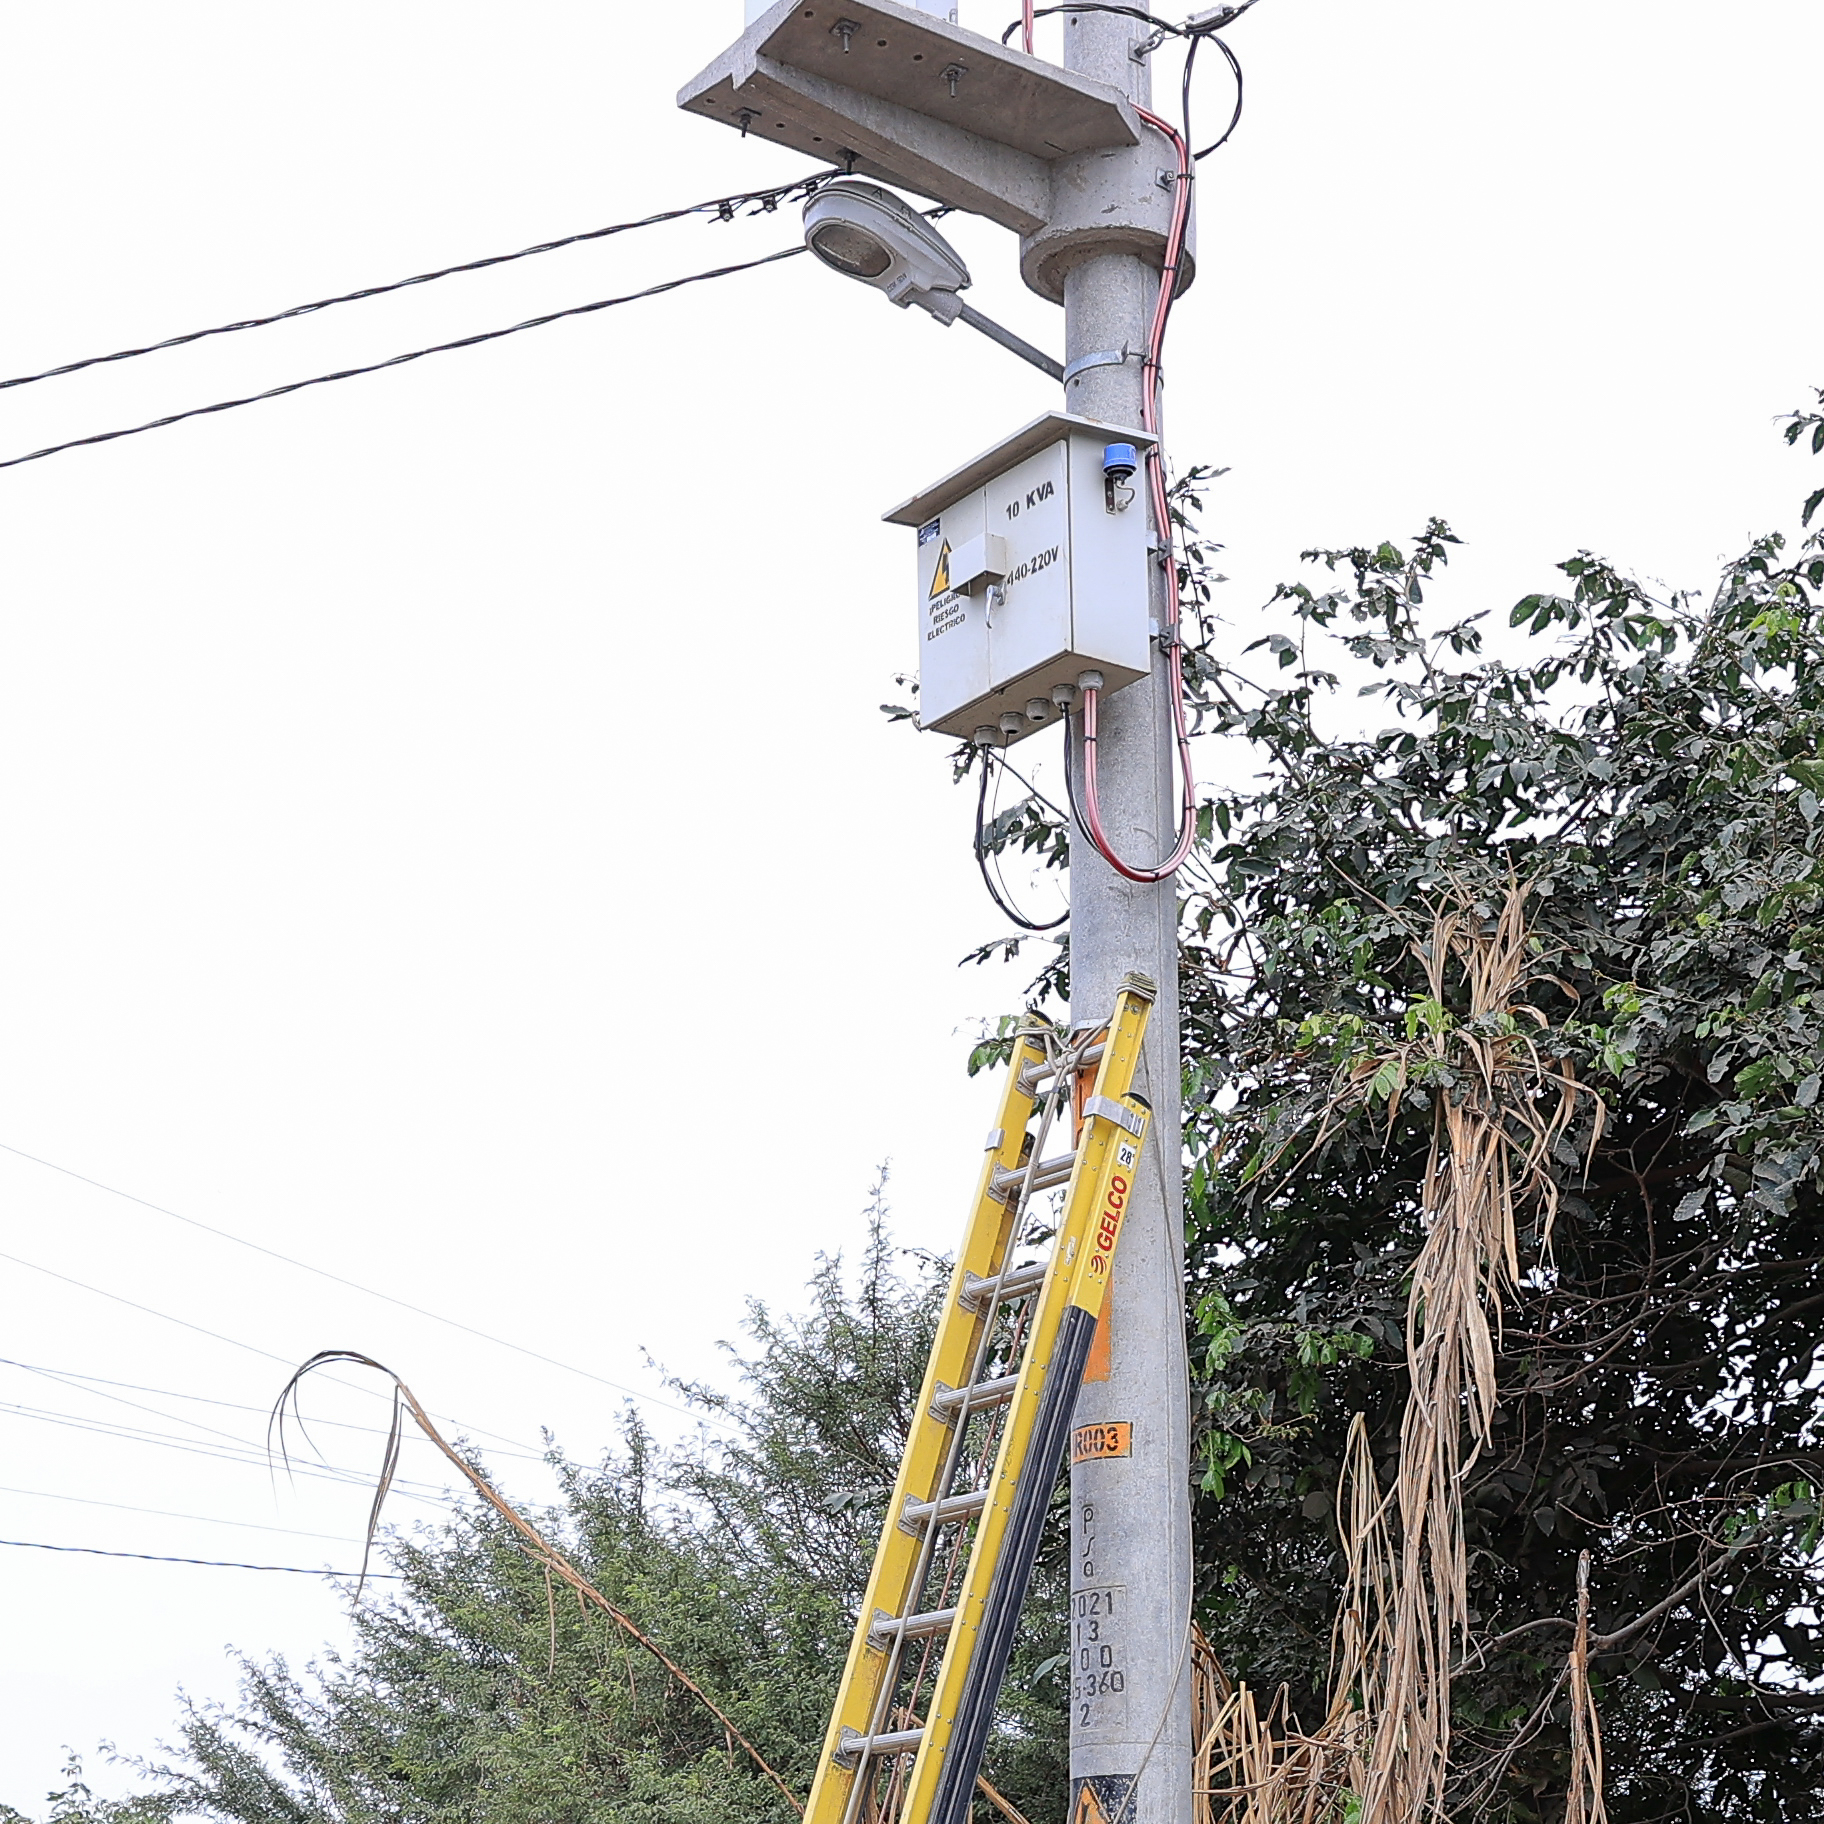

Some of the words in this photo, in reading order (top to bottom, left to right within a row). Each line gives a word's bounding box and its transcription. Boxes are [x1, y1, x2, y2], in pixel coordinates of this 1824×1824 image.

[1006, 500, 1020, 521] 10
[1026, 480, 1054, 510] KVA
[1006, 545, 1059, 586] 440-220V
[927, 613, 966, 641] ELECTRICO
[933, 603, 959, 625] RIESGO
[1096, 1175, 1128, 1252] GELCO
[1080, 1703, 1091, 1727] 2
